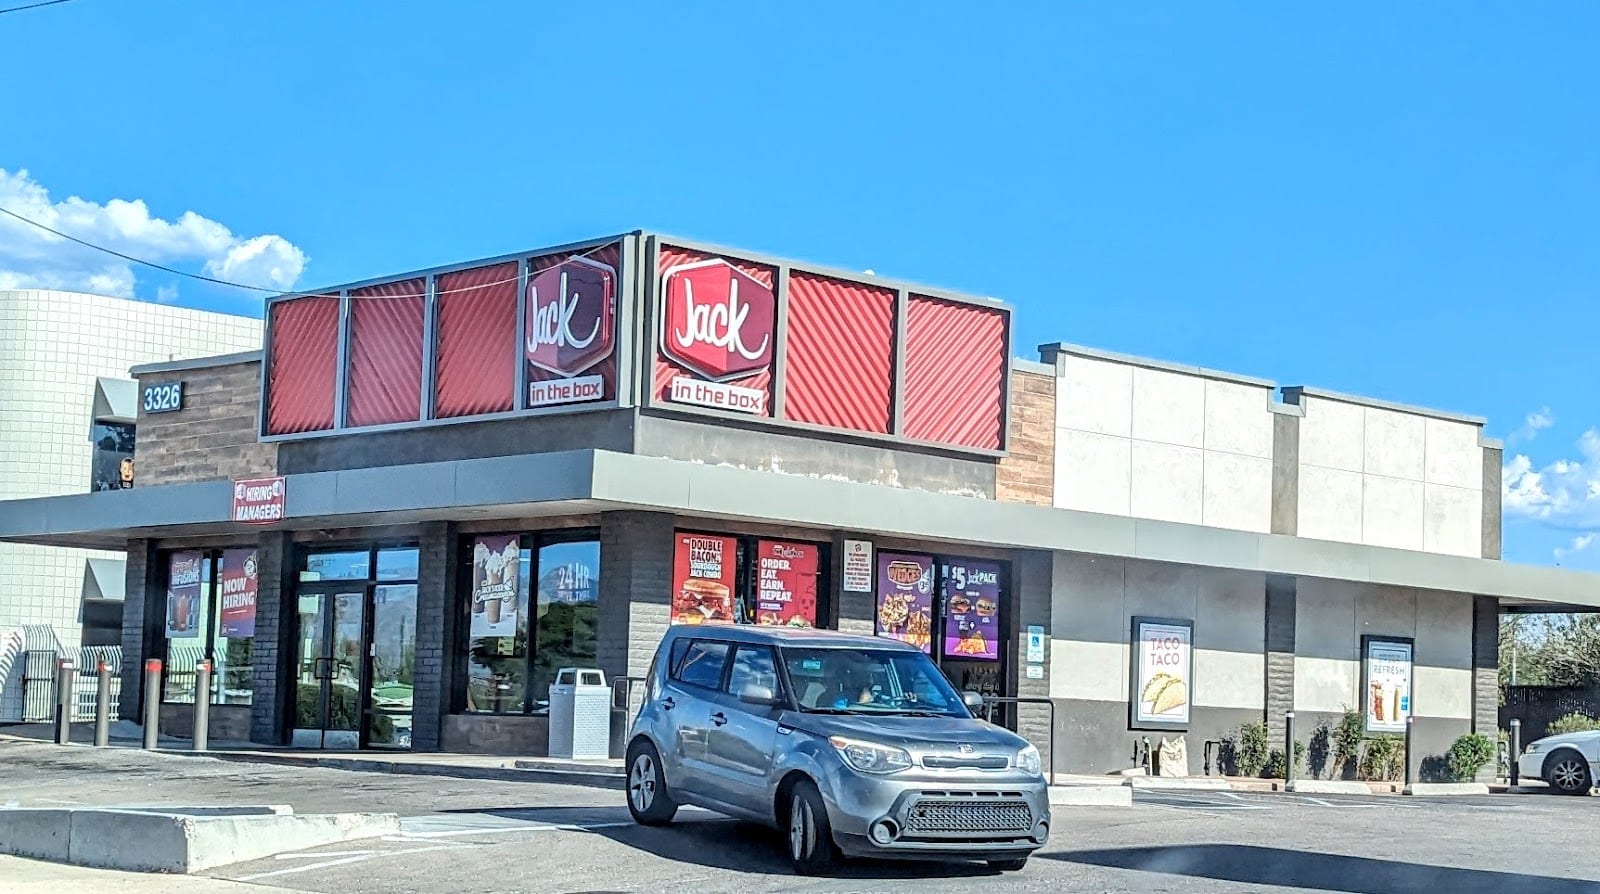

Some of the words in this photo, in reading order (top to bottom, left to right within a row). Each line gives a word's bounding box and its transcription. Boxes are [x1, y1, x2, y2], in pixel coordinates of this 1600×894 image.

[527, 272, 600, 353] Jack
[675, 277, 769, 360] Jack
[143, 384, 180, 411] 3326
[532, 385, 545, 402] in
[547, 383, 570, 400] the
[572, 380, 600, 398] box
[674, 381, 690, 398] in
[696, 383, 723, 404] the
[728, 386, 761, 410] box
[246, 486, 273, 501] HIRING
[236, 504, 282, 520] MANAGERS
[690, 538, 722, 551] DOUBLE
[761, 558, 791, 570] ORDER.
[559, 562, 573, 590] 24
[575, 562, 590, 589] HR
[951, 566, 966, 590] $5
[223, 577, 247, 594] NOW
[223, 592, 255, 609] HIRING
[760, 589, 793, 602] REPEAT.
[1150, 637, 1180, 651] TACO
[1150, 653, 1180, 666] TACO
[1373, 664, 1404, 675] REFRESH
